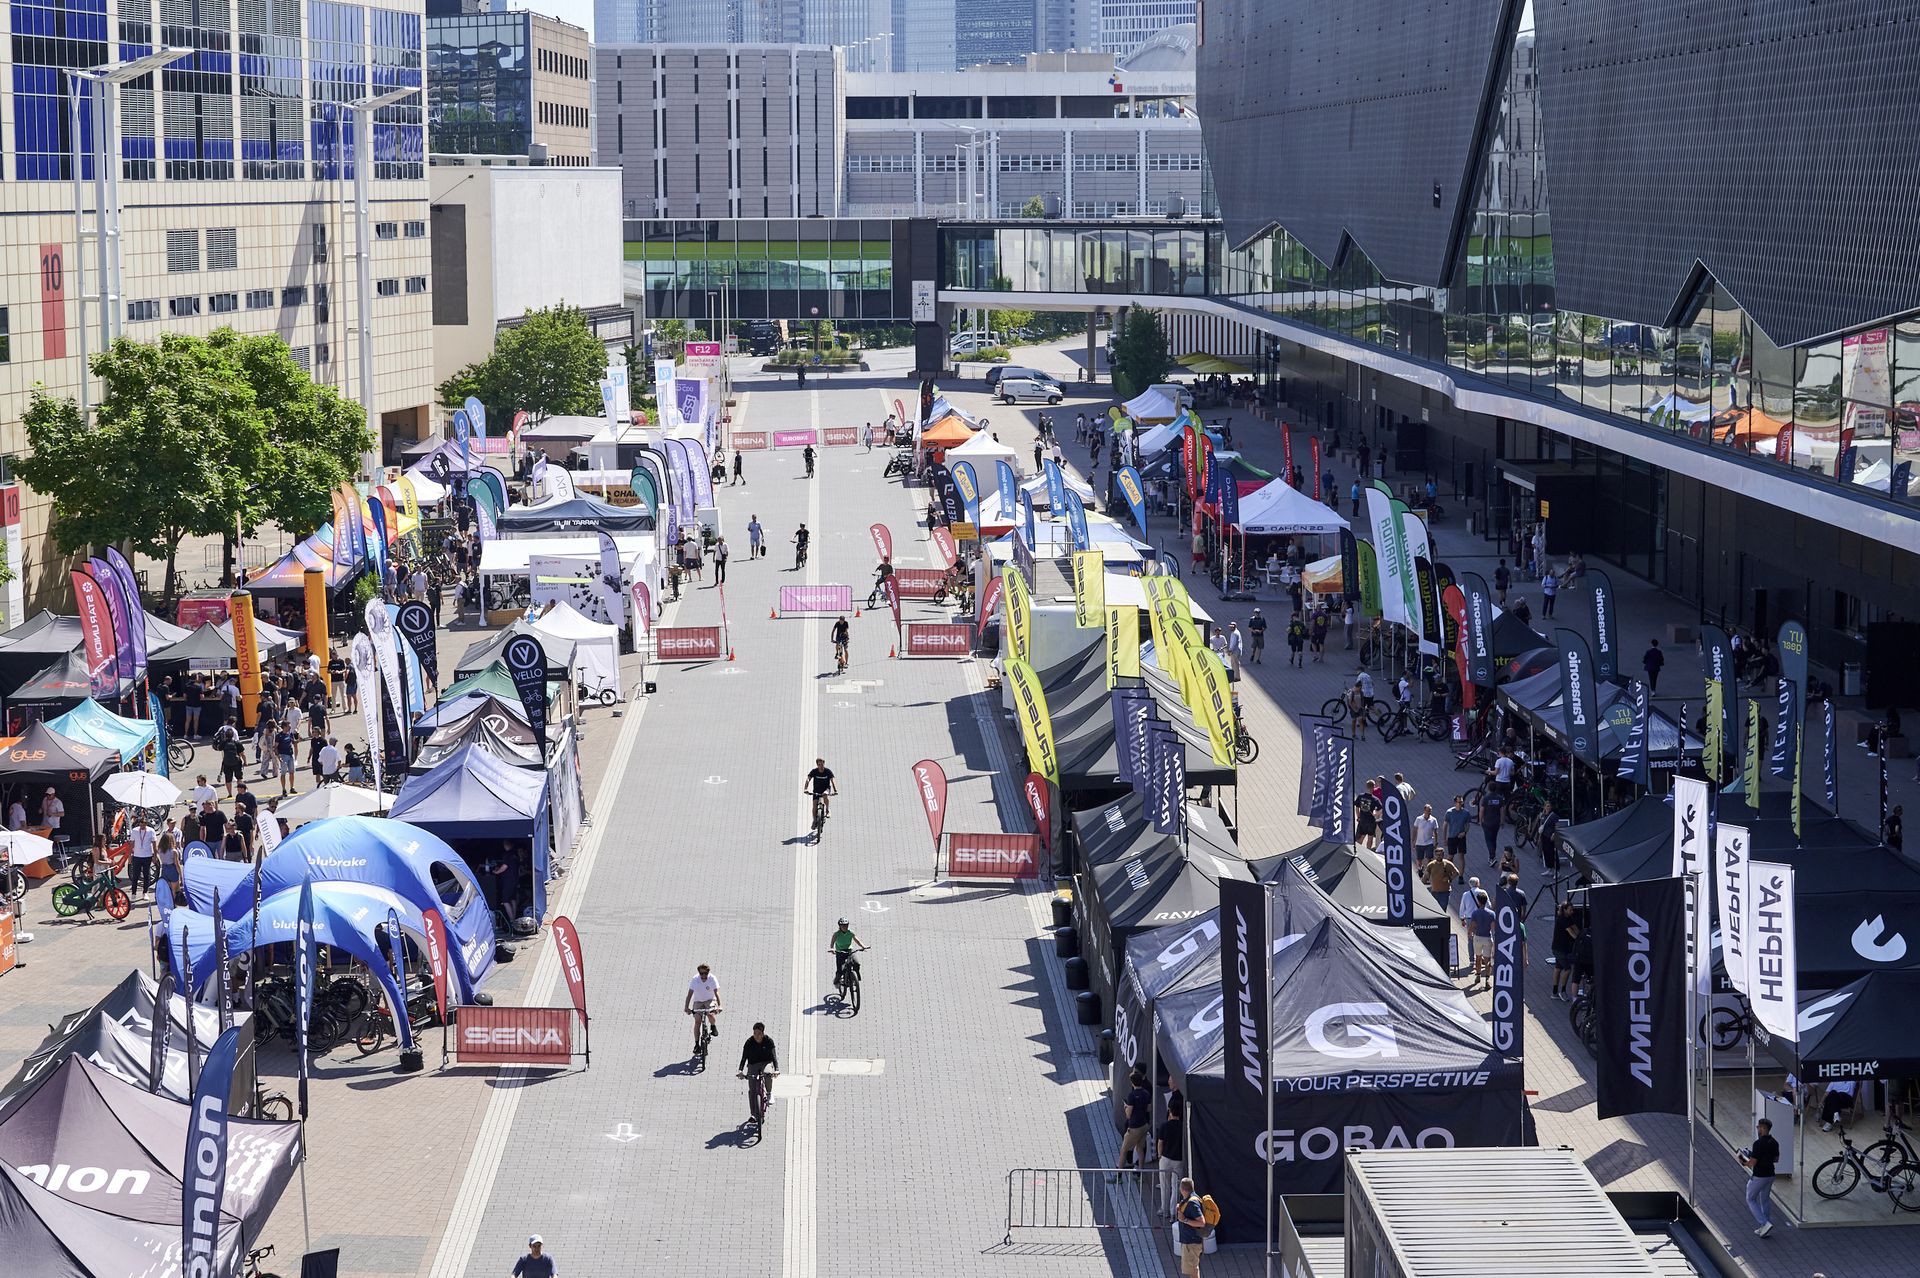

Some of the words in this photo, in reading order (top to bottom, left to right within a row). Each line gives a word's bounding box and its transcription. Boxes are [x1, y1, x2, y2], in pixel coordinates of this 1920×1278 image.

[42, 253, 61, 291] 10
[695, 346, 711, 354] F12
[734, 436, 765, 445] SENA
[826, 432, 856, 441] SENA
[7, 495, 18, 517] 10
[234, 602, 251, 679] REGISTRATION
[411, 630, 435, 645] VELLO
[660, 637, 717, 649] SENA
[912, 634, 966, 646] SENA
[514, 668, 543, 681] VELLO
[9, 750, 48, 763] igus
[69, 771, 87, 782] igus
[307, 855, 367, 868] blubrake
[956, 848, 1033, 864] SENA
[1386, 795, 1406, 920] GOBAO
[1495, 904, 1517, 1052] GOBAO
[465, 1026, 564, 1047] SENA
[1818, 1062, 1875, 1078] HEPHA
[1285, 1076, 1342, 1092] YOUR
[1344, 1071, 1490, 1089] PERSPECTIVE
[16, 1163, 151, 1195] nion
